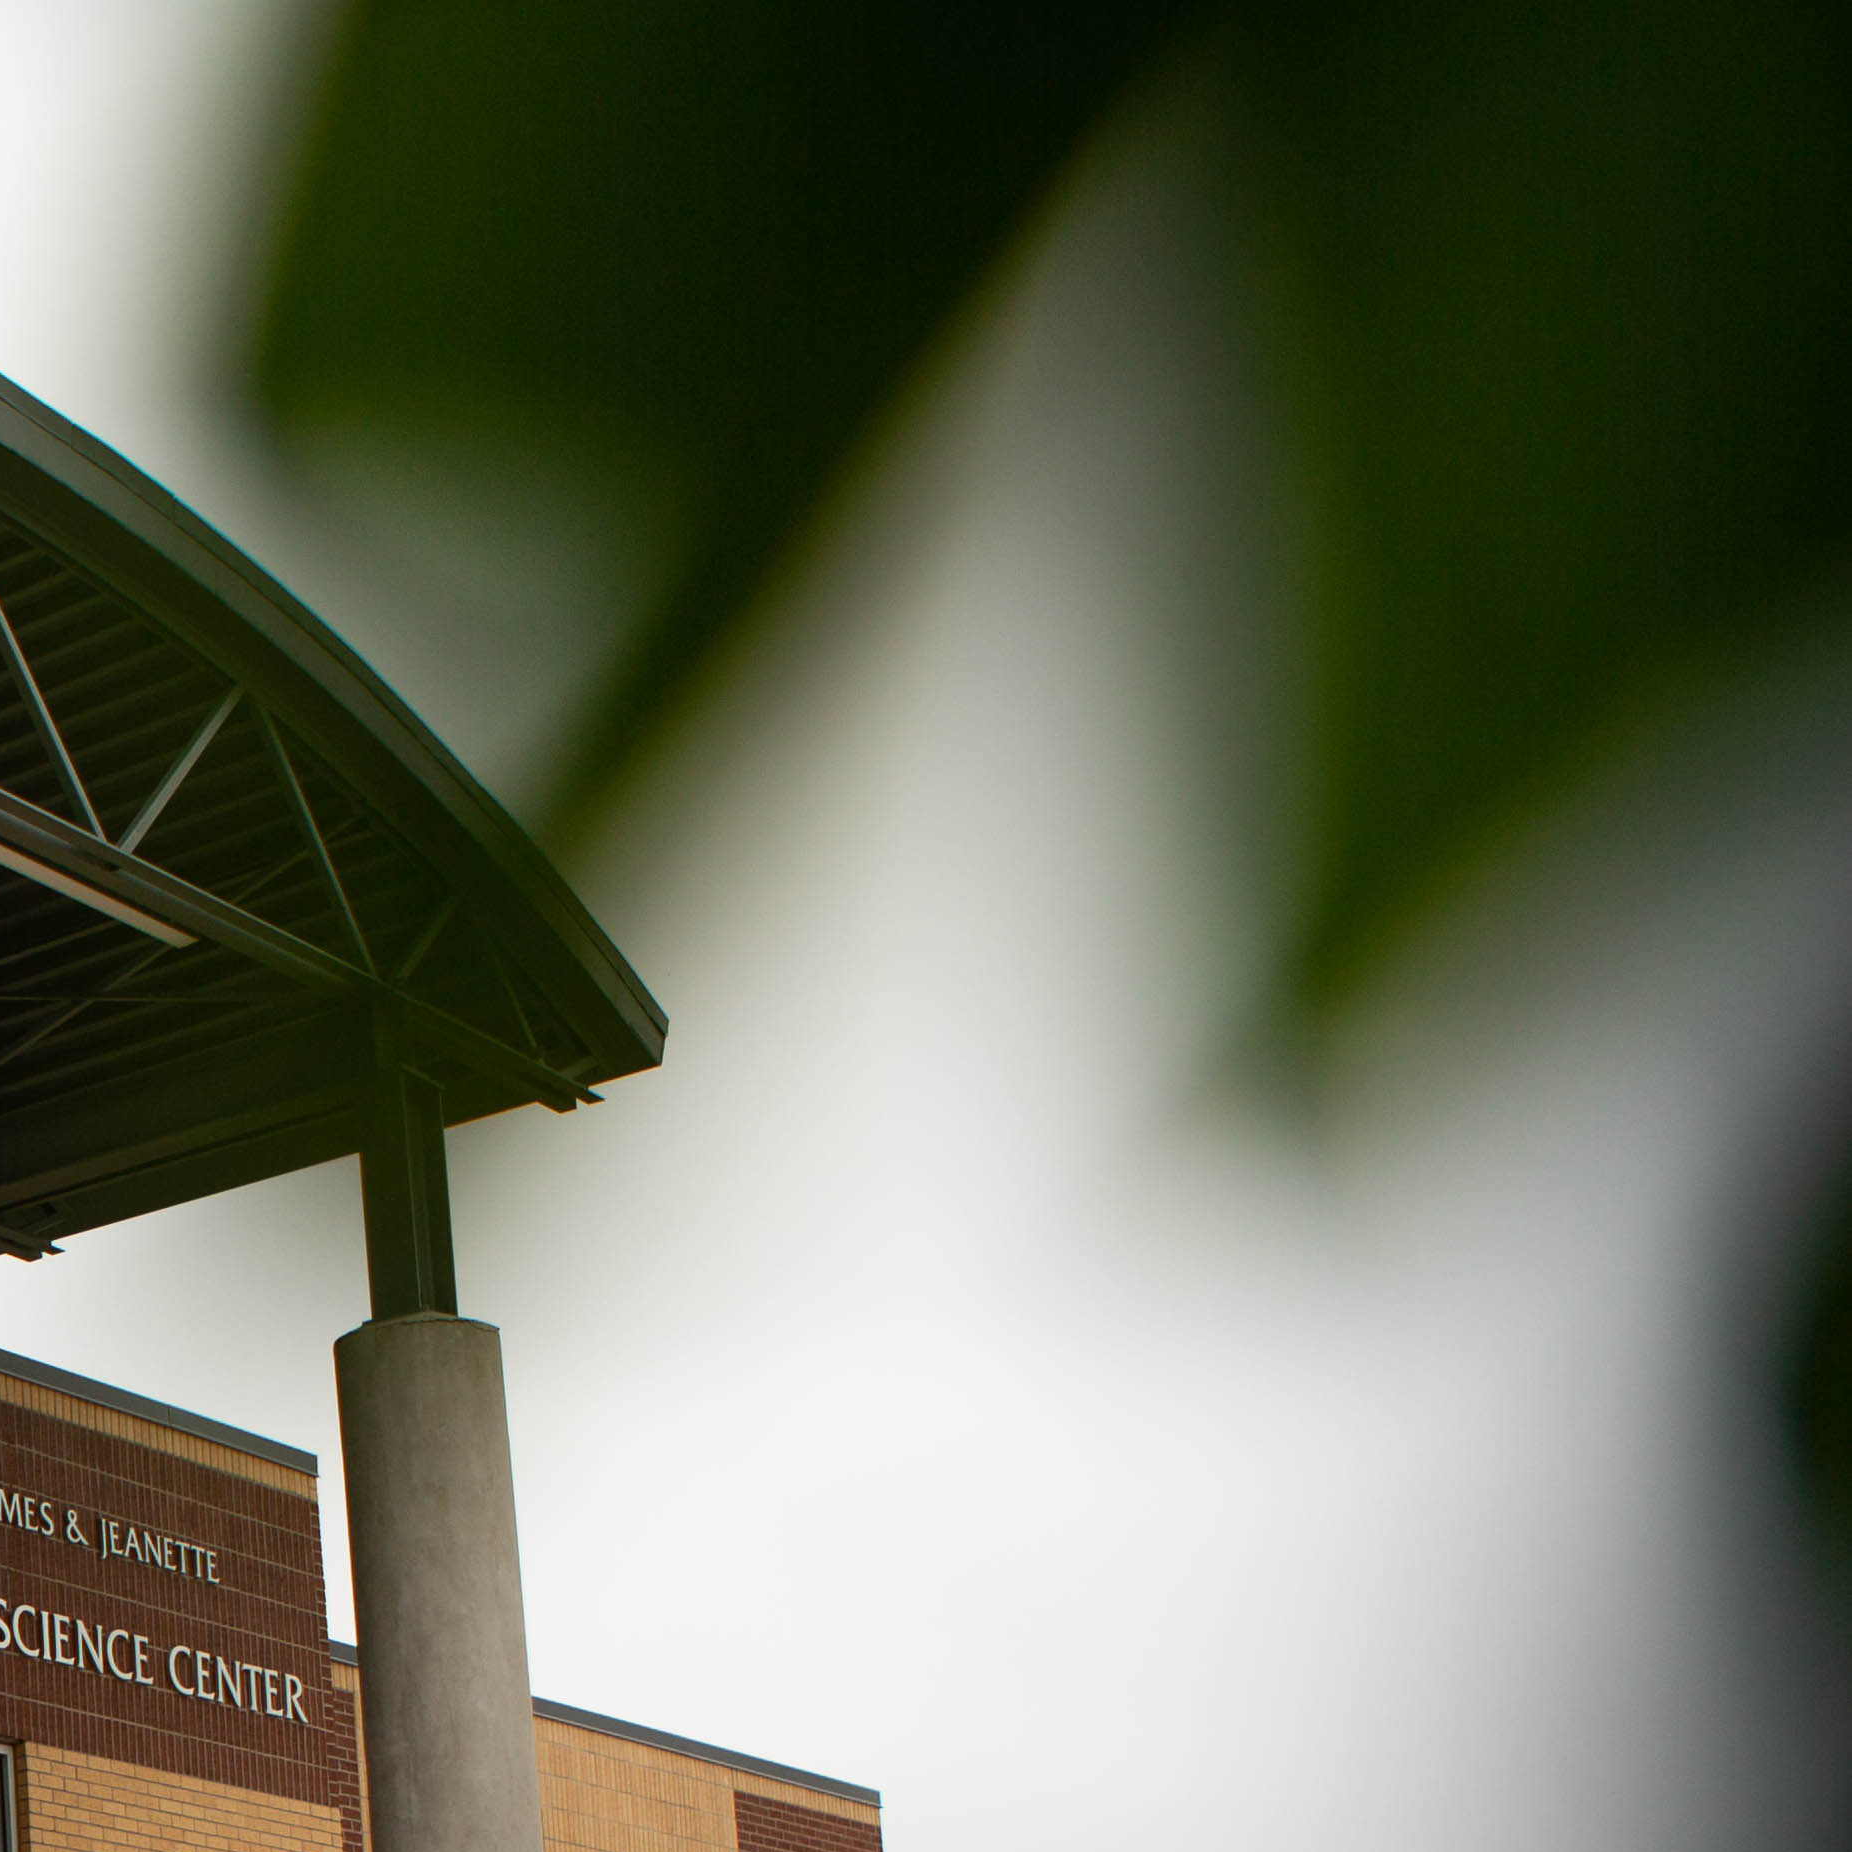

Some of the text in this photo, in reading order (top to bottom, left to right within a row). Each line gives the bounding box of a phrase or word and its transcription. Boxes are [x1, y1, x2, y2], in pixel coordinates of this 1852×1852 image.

[66, 1509, 89, 1546] &
[100, 1517, 220, 1584] JEANETTE
[168, 1644, 309, 1724] CENTER
